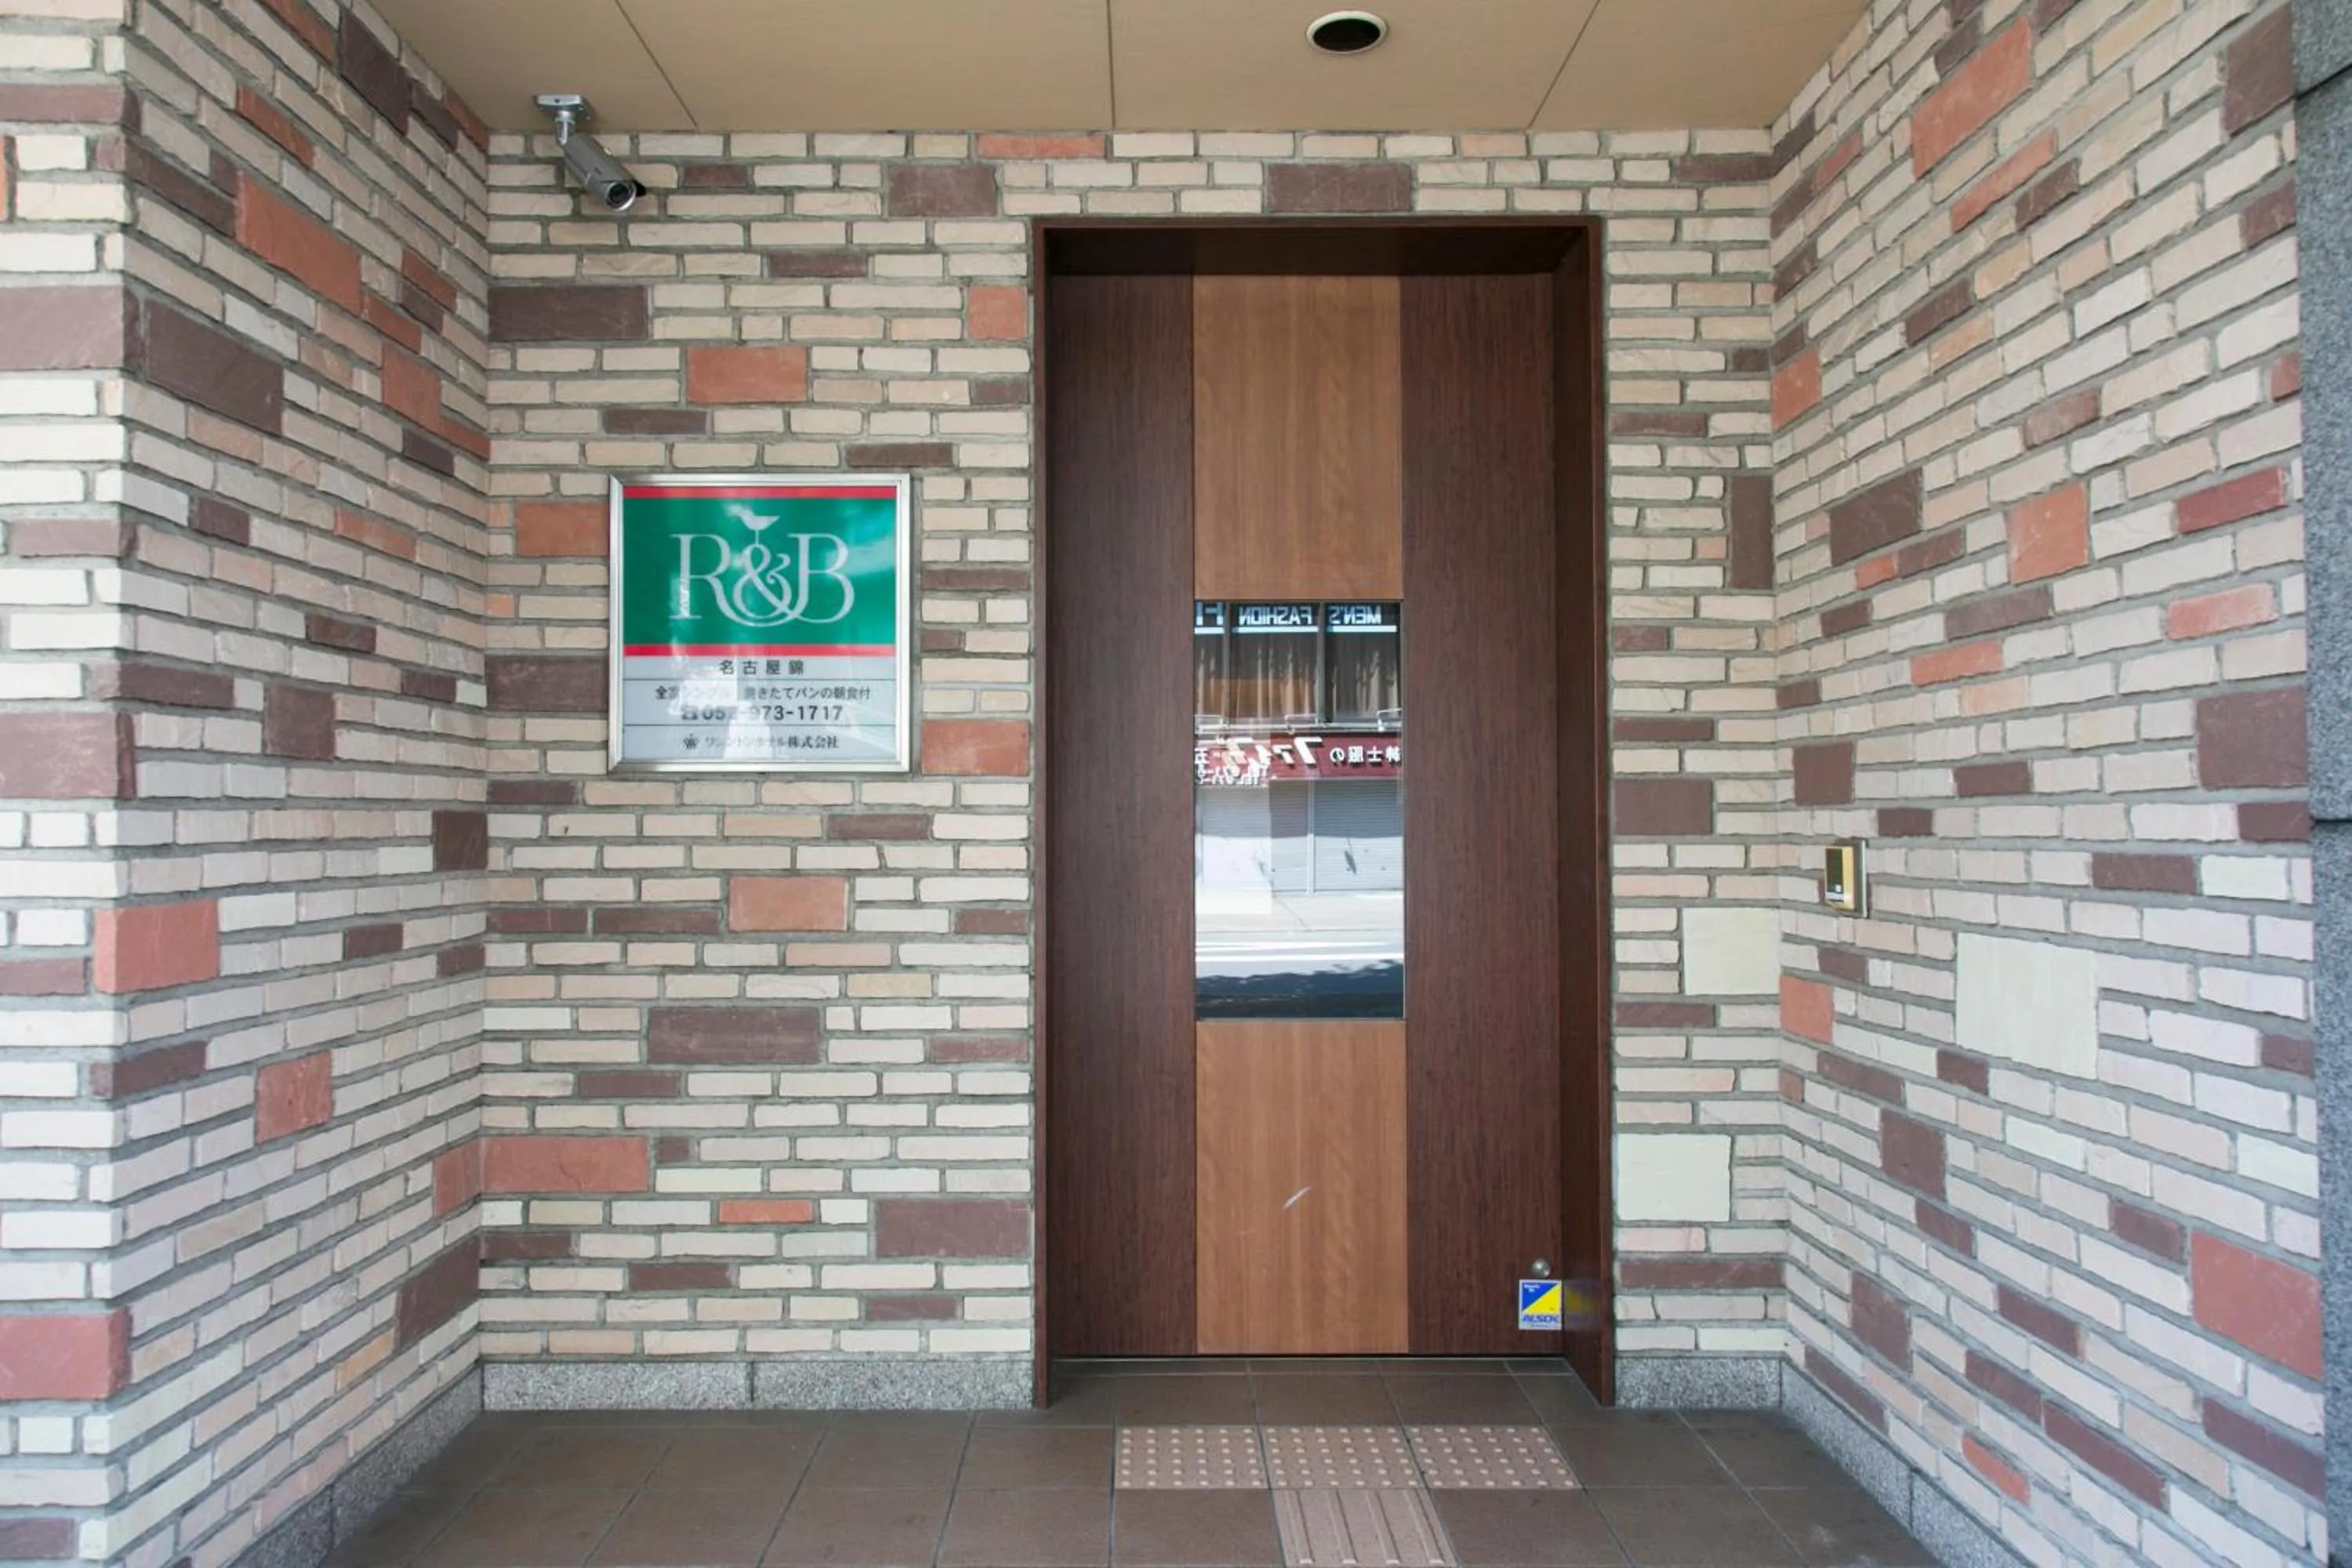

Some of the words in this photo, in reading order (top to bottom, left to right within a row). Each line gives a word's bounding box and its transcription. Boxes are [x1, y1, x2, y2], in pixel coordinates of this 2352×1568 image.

[668, 533, 855, 627] R&B
[719, 659, 804, 676] 名古屋錦
